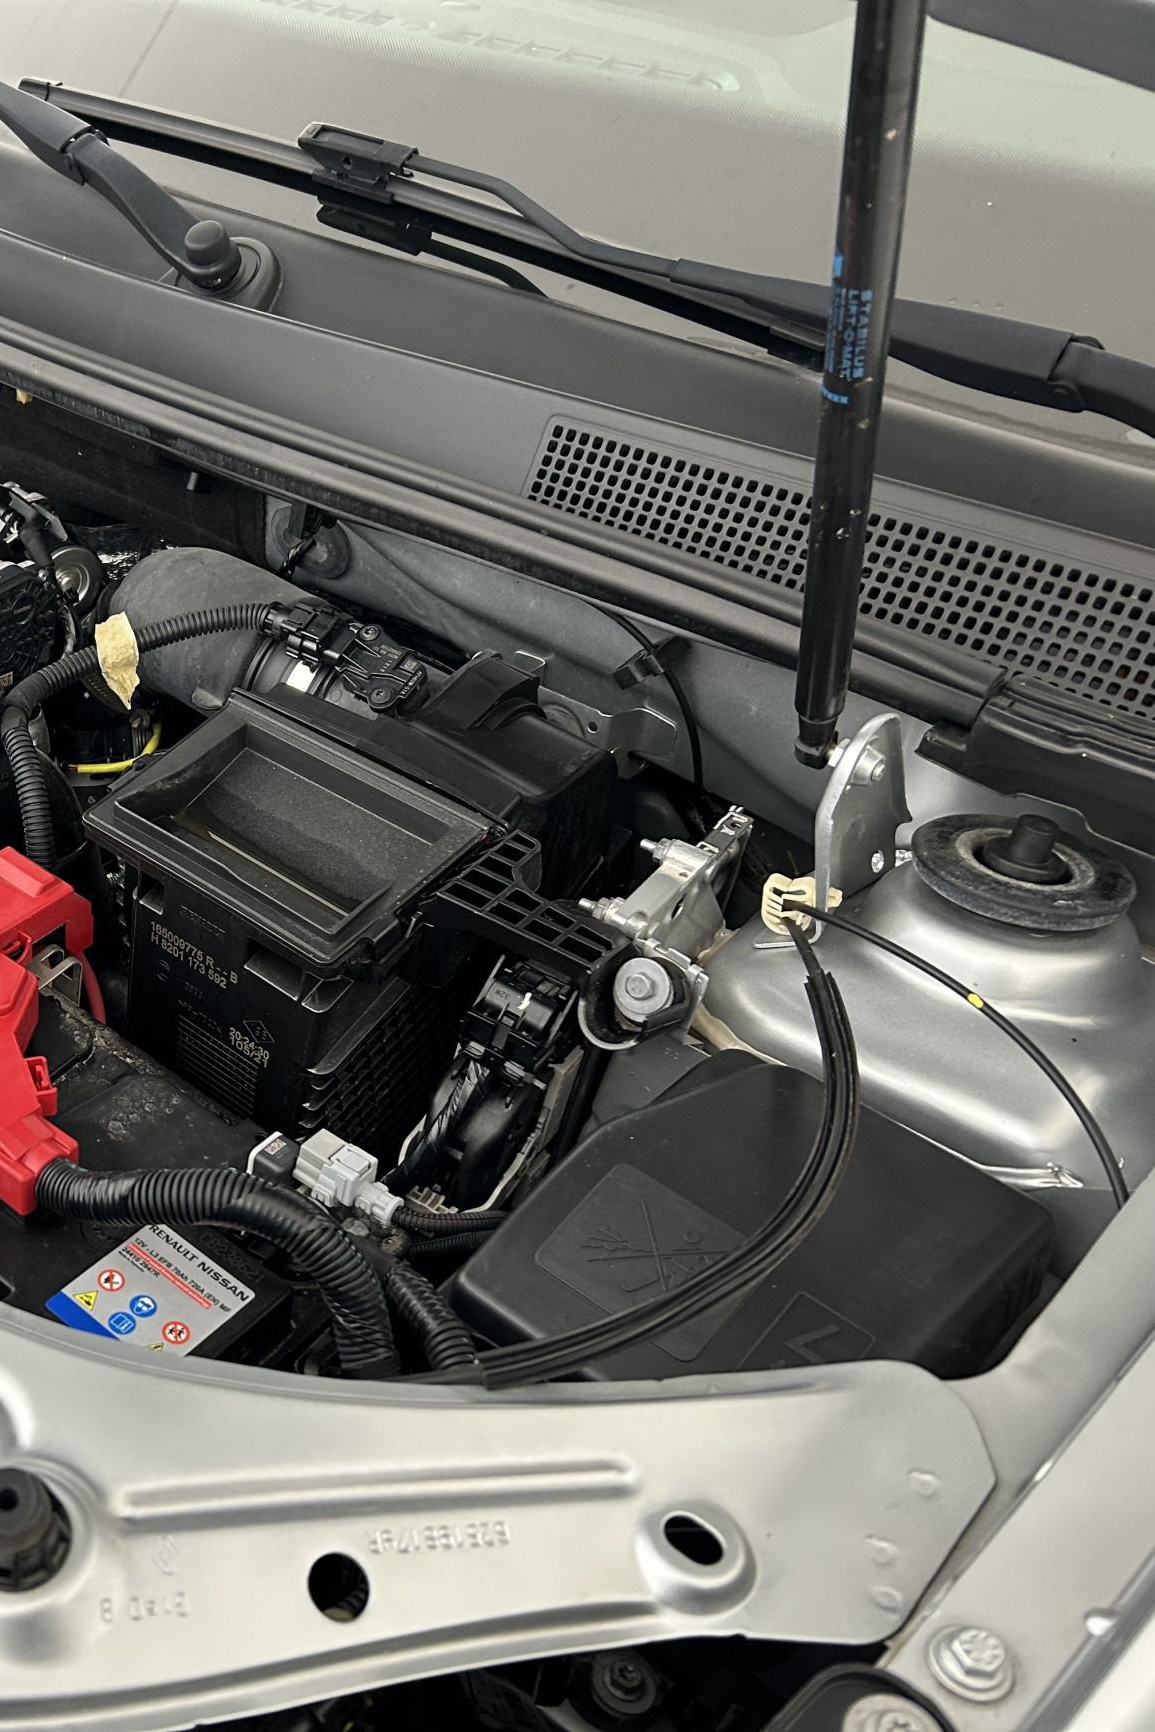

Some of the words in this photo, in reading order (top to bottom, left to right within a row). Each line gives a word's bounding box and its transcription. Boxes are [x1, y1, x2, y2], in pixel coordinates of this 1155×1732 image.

[851, 289, 873, 378] STABILUS
[150, 921, 204, 961] 165009775
[151, 932, 159, 945] H
[161, 938, 184, 961] 8201
[187, 956, 206, 975] 173
[208, 968, 227, 989] 592
[134, 1237, 148, 1249] 12V
[148, 1224, 199, 1262] RENAULT
[196, 1261, 250, 1302] NISSAN
